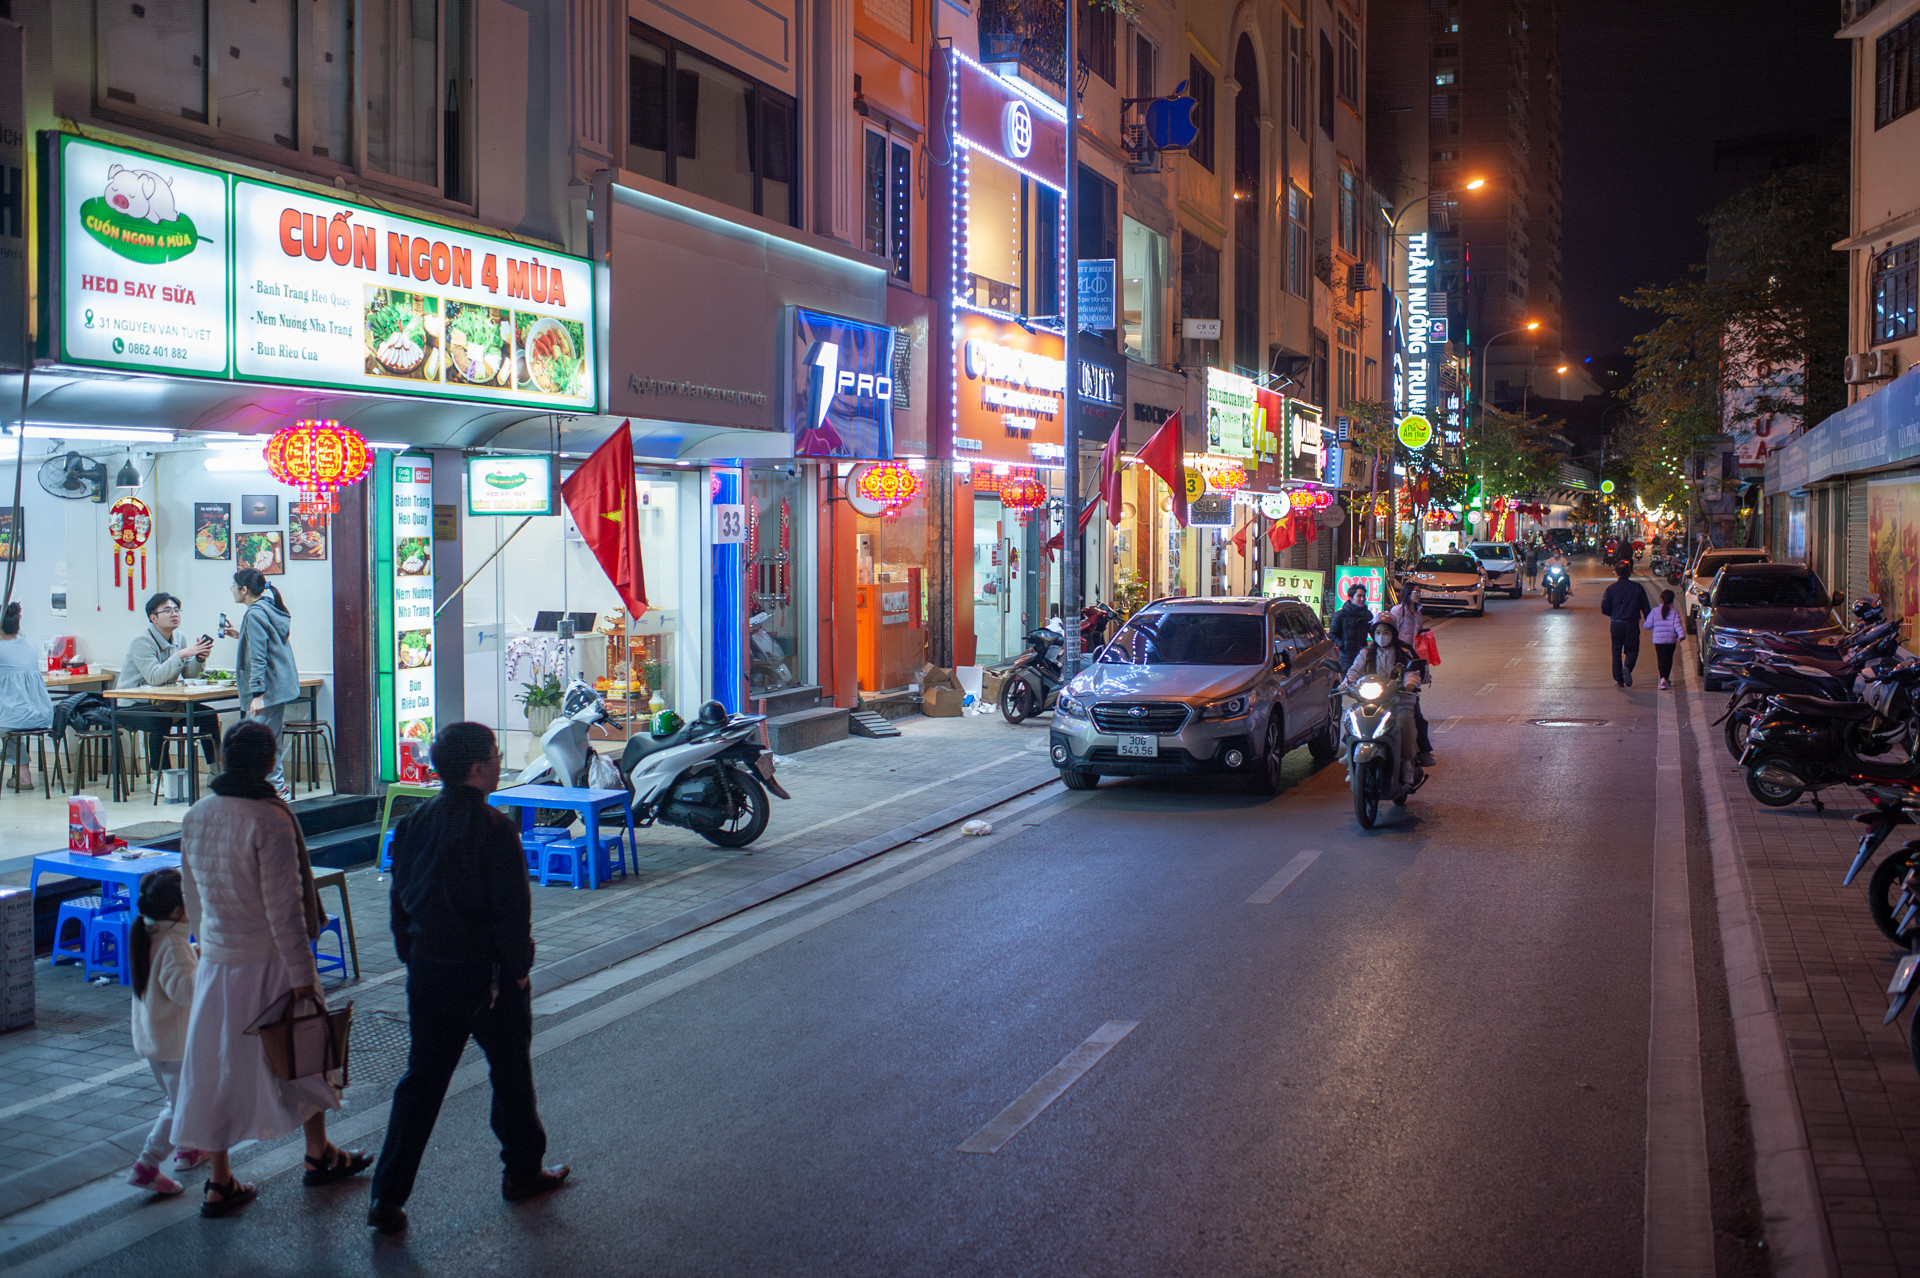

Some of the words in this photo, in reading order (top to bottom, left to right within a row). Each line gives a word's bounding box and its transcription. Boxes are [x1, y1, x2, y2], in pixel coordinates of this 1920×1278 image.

[86, 215, 120, 240] CUỐN
[122, 229, 155, 247] NGON
[157, 235, 165, 248] 4
[166, 232, 192, 248] MÙA
[279, 207, 377, 271] CUỐN
[387, 231, 472, 289] NGON
[481, 253, 499, 294] 4
[507, 256, 566, 308] MÙA
[81, 274, 119, 294] HEO
[124, 280, 157, 300] SAY
[162, 284, 197, 306] SỮA
[311, 289, 328, 304] Heo
[99, 317, 110, 329] 31
[256, 310, 277, 326] Nem
[309, 318, 326, 333] Nha
[329, 321, 353, 339] Trang
[128, 342, 150, 356] 0862
[153, 345, 168, 357] 401
[171, 348, 187, 360] 882
[301, 346, 319, 361] Cua
[838, 370, 892, 400] PRO
[1187, 479, 1196, 493] 3
[398, 512, 410, 525] Heo
[413, 512, 428, 526] Quay
[722, 511, 741, 537] 33
[1277, 575, 1314, 590] BÚN
[395, 588, 411, 600] Nem
[398, 606, 411, 618] Nha
[413, 605, 430, 618] Trang
[417, 696, 429, 708] Cua
[1129, 736, 1148, 746] 30G
[1121, 745, 1154, 756] 543.56
